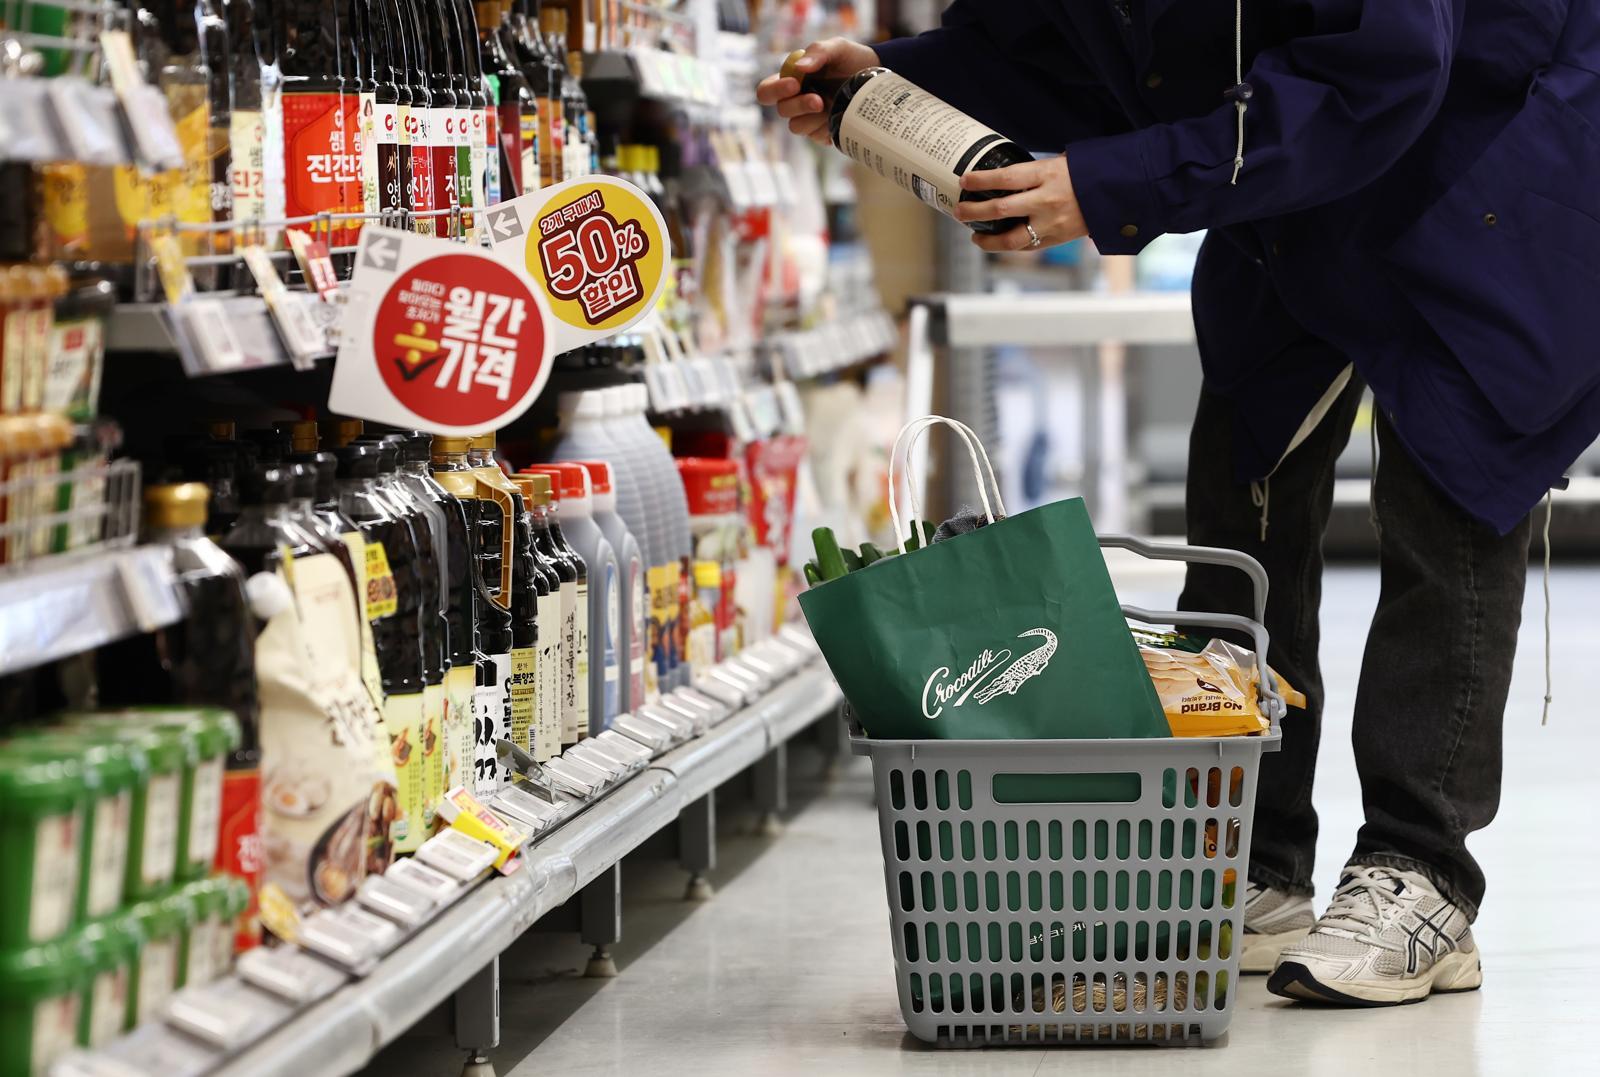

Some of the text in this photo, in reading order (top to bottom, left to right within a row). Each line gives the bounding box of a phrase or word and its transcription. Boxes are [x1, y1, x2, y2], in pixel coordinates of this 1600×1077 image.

[540, 192, 602, 236] 2개 구매시
[542, 214, 644, 295] 50%
[443, 286, 527, 350] 월간
[580, 264, 639, 319] 할인
[433, 337, 518, 401] 가격
[922, 649, 1011, 719] Crocodile
[1181, 700, 1243, 714] No Brand
